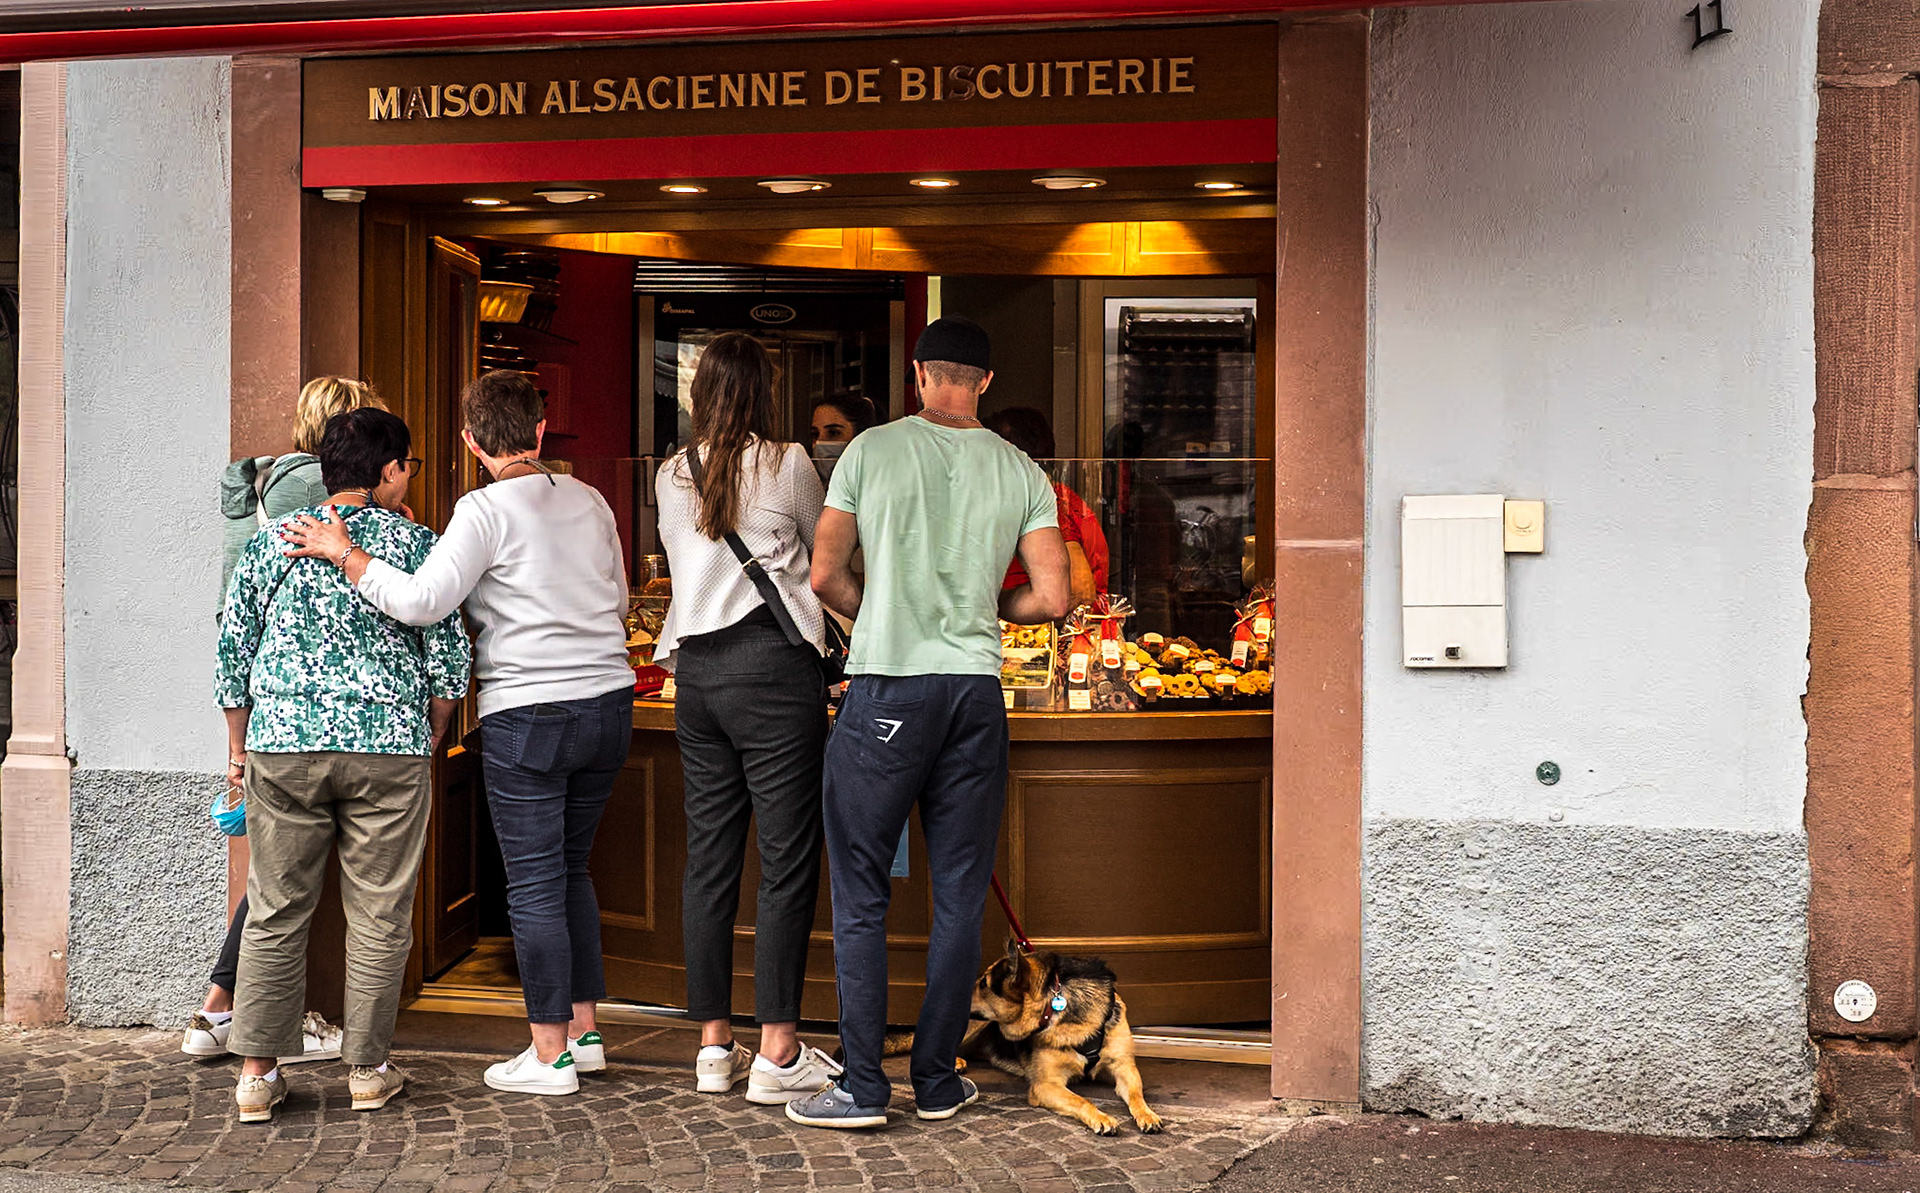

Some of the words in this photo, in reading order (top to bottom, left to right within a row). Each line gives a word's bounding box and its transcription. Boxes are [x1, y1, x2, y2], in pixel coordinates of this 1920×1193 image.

[1685, 0, 1733, 50] 11
[368, 82, 527, 120] MAISON
[540, 70, 807, 114] ALSACIENNE
[825, 68, 882, 106] DE
[900, 56, 1196, 102] BISCUITERIE
